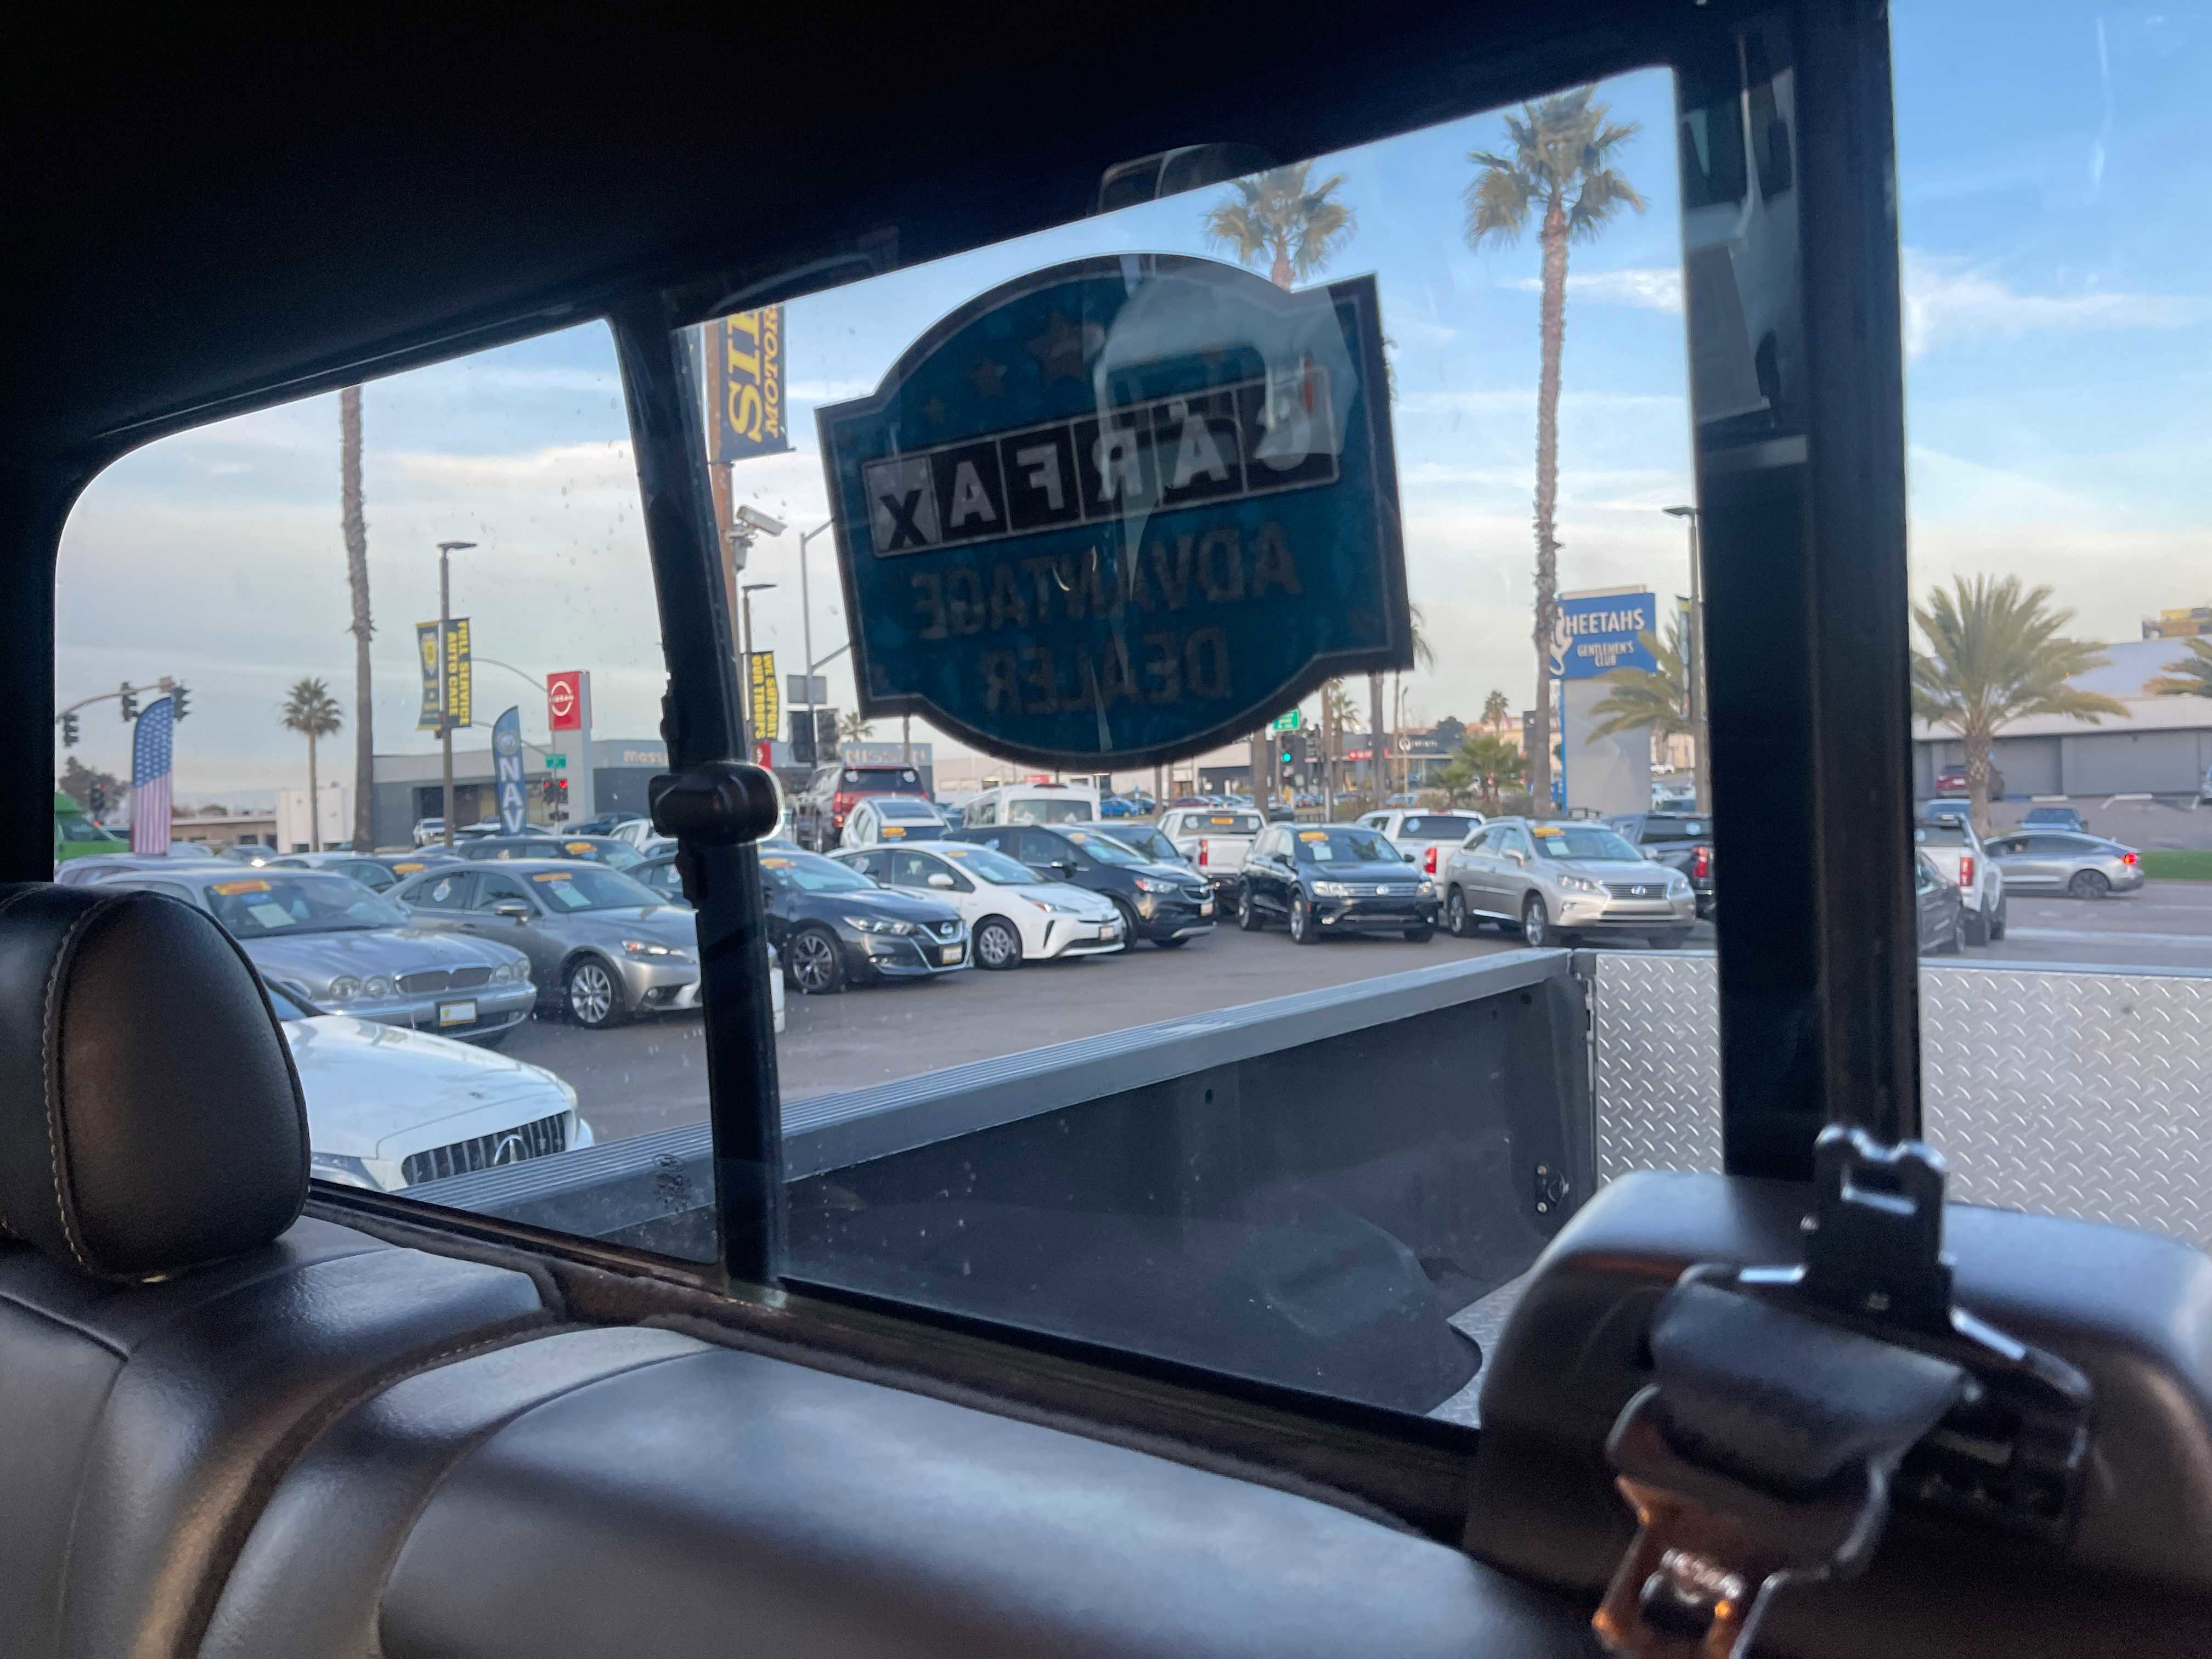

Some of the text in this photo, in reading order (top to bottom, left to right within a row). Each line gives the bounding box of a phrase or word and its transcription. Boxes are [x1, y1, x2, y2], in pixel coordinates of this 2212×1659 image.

[447, 632, 459, 716] AUTO CARE
[458, 620, 470, 726] FULL SERVICE
[752, 654, 764, 685] OUR
[1595, 655, 1617, 667] CLUB
[753, 686, 766, 739] TROOPS
[765, 677, 778, 738] SUPPORT
